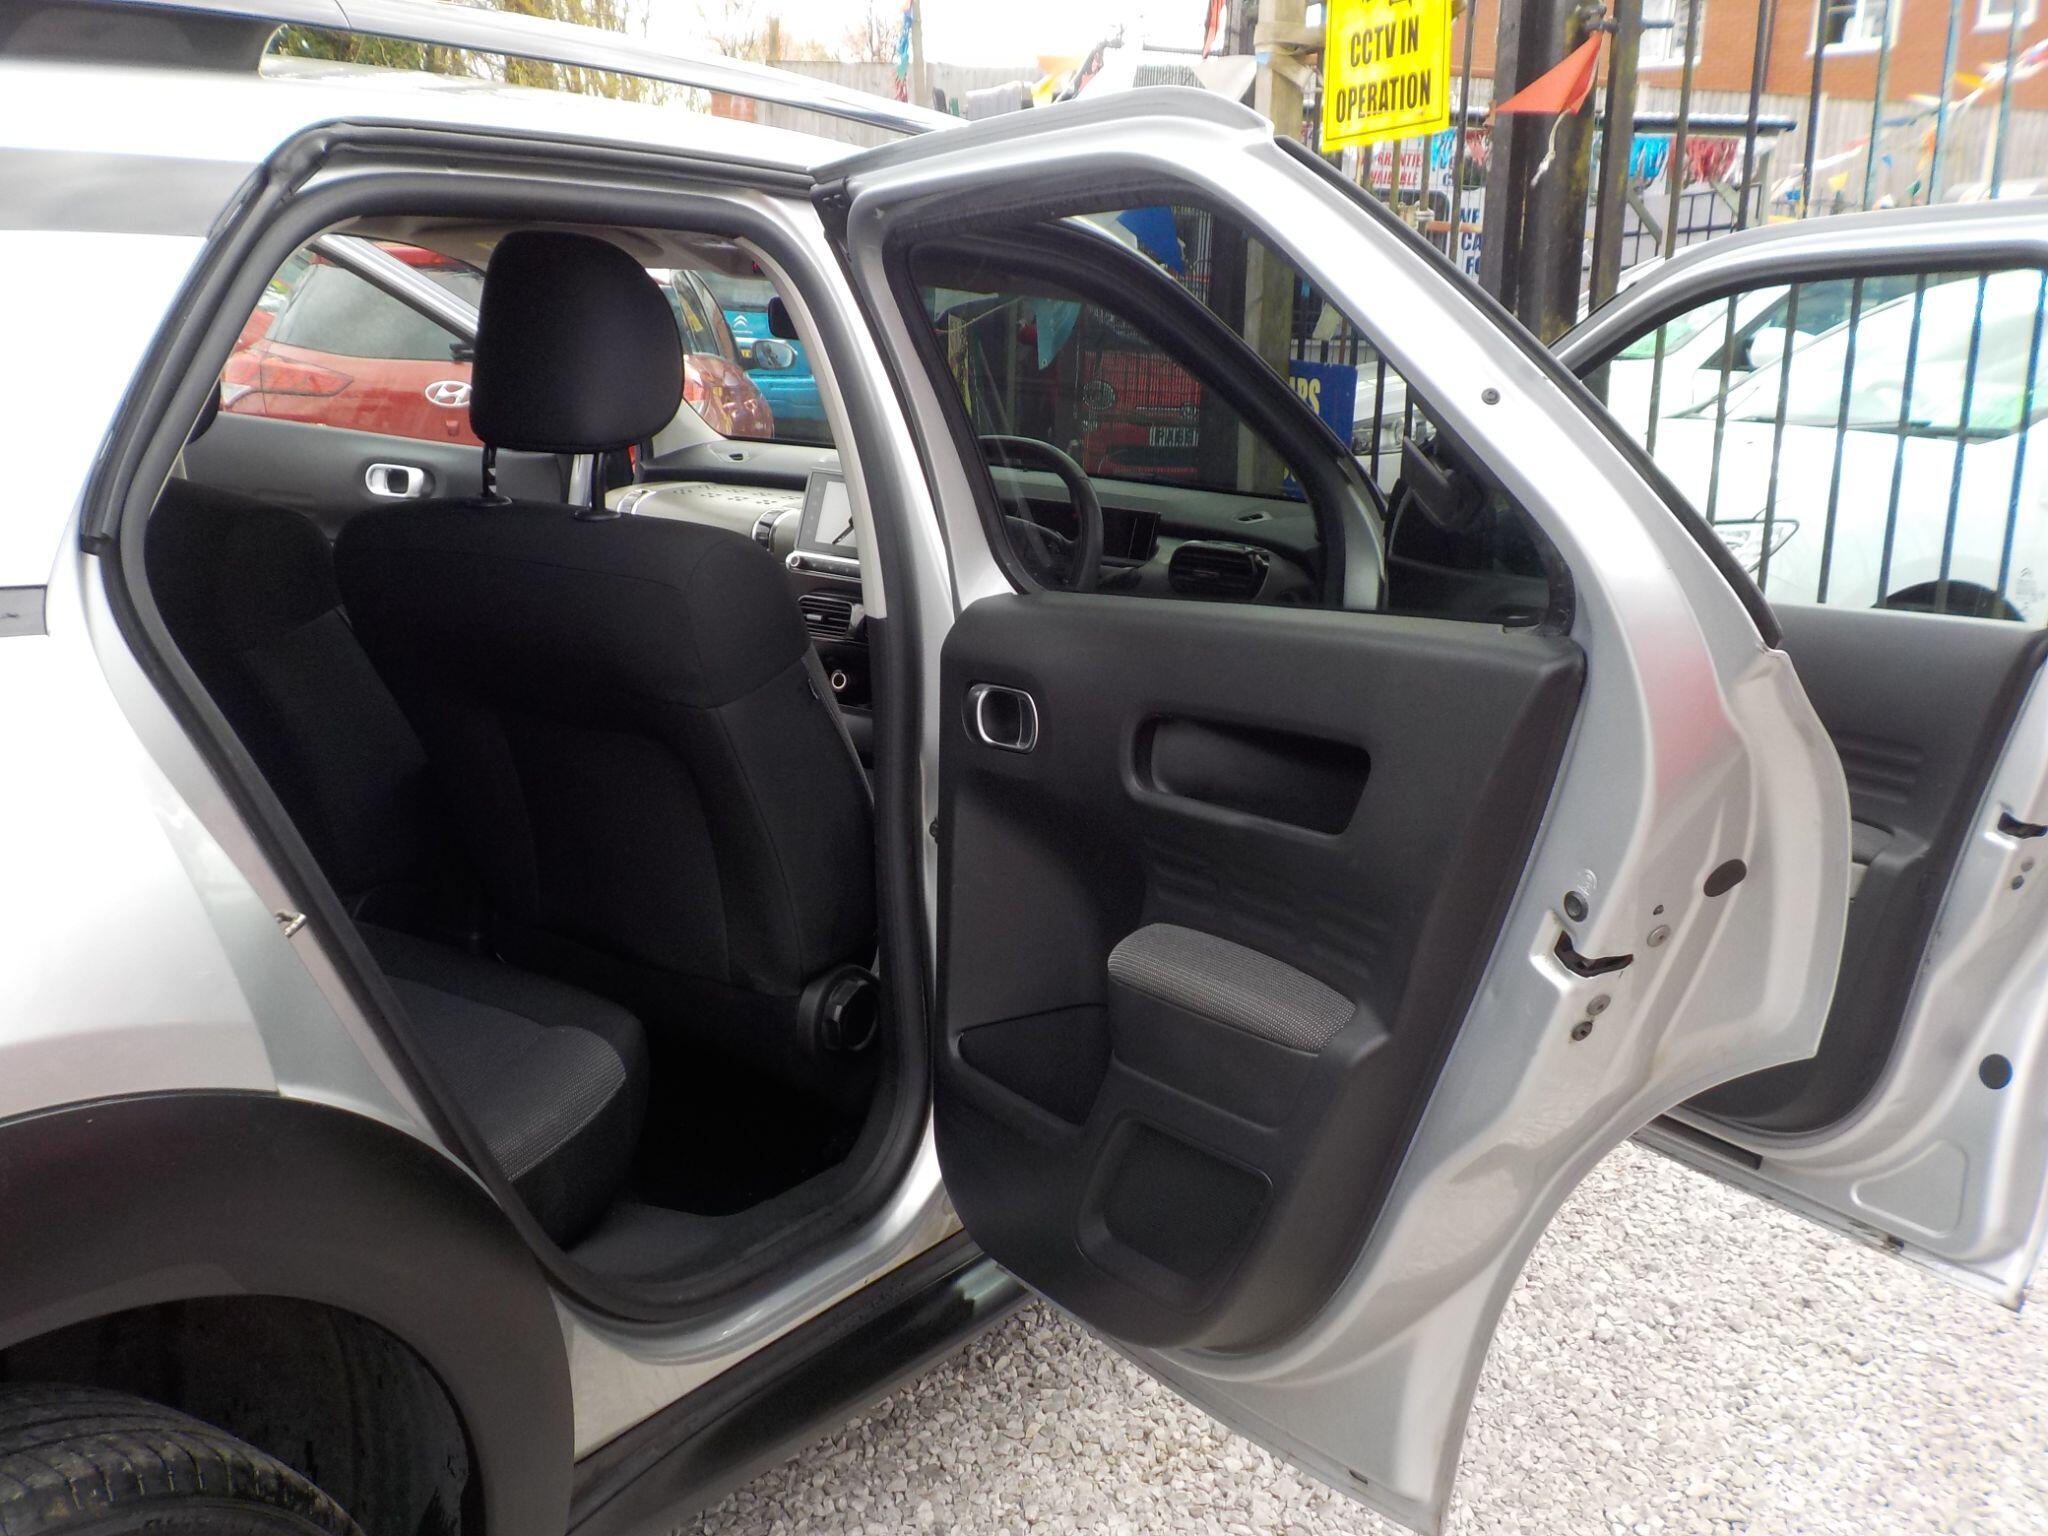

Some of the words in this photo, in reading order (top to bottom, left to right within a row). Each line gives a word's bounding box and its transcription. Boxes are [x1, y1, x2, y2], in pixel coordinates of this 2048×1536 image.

[1350, 22, 1396, 68] CCTV
[1400, 15, 1419, 55] IN
[1336, 68, 1431, 123] OPERATION
